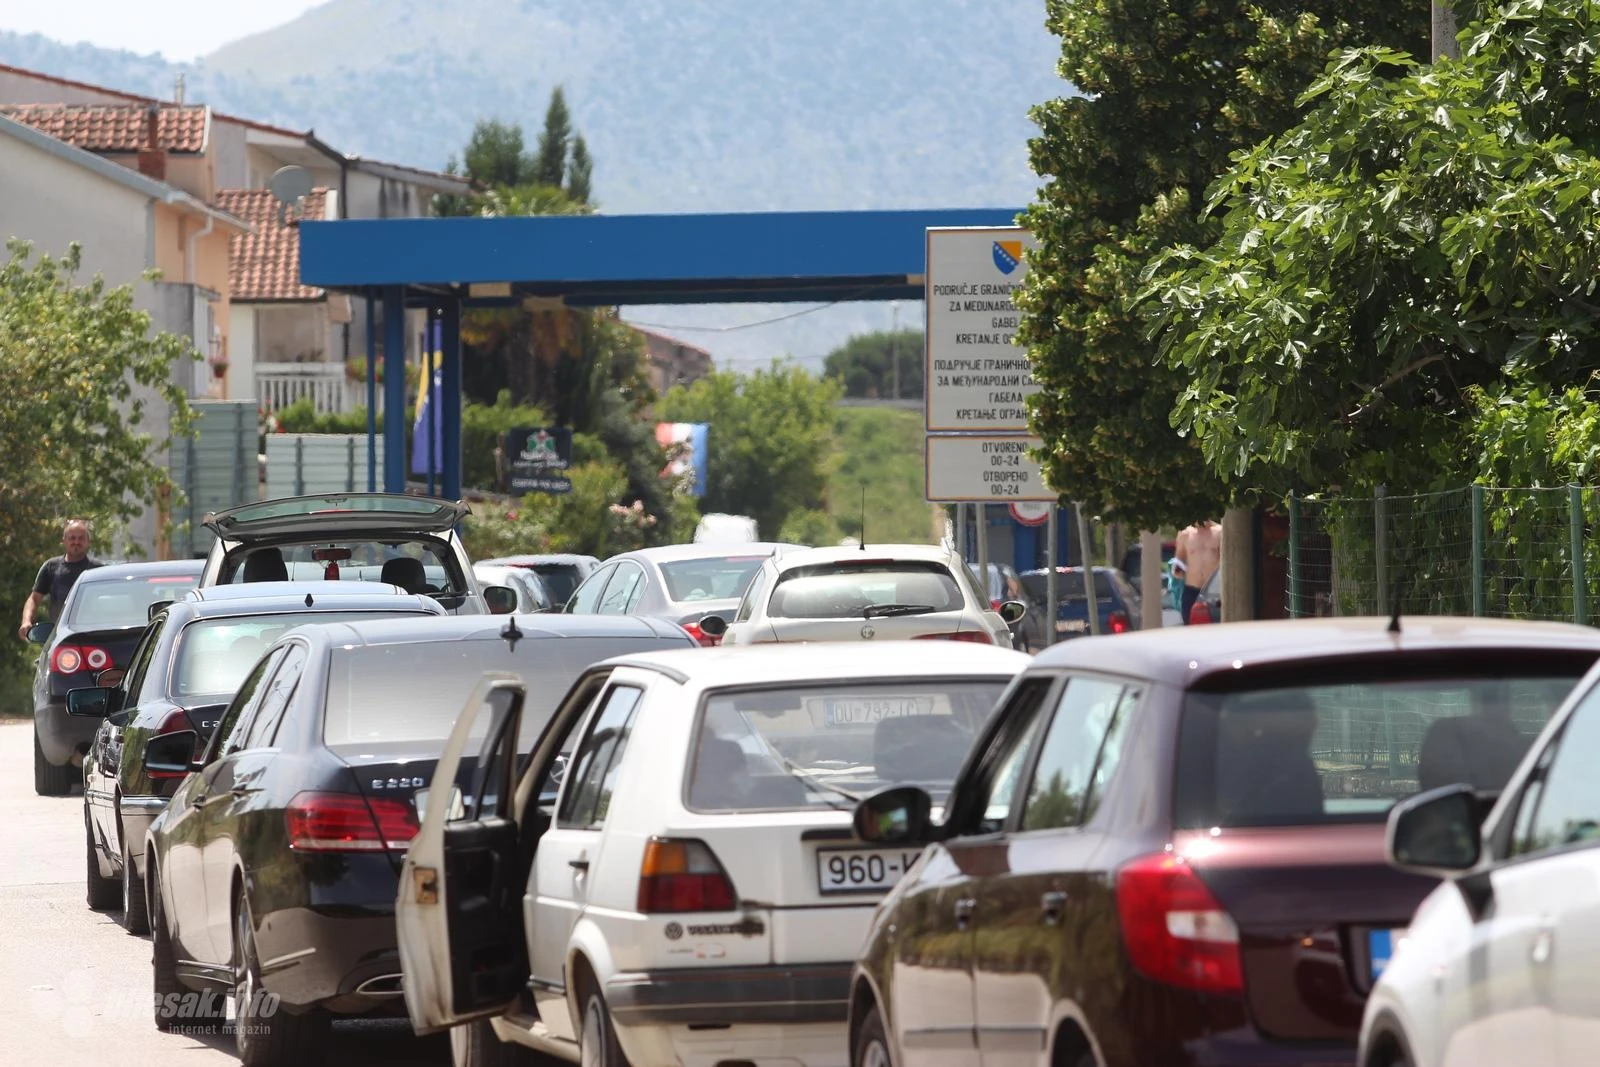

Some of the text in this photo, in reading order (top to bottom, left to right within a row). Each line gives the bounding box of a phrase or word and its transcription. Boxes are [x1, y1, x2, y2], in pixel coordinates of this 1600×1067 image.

[934, 282, 978, 295] PODRUČJE
[949, 301, 961, 311] ZA
[956, 333, 999, 344] KRETANJE
[934, 360, 981, 370] ПОДРУЧЈЕ
[937, 376, 949, 386] ЗА
[989, 392, 1023, 402] ГАБЕЛА
[956, 409, 997, 420] КРЕТАЊЕ
[991, 455, 1019, 466] 00-24
[983, 471, 1028, 482] ОТВОРЕНО
[991, 484, 1019, 495] 00-24
[372, 777, 424, 789] E 220
